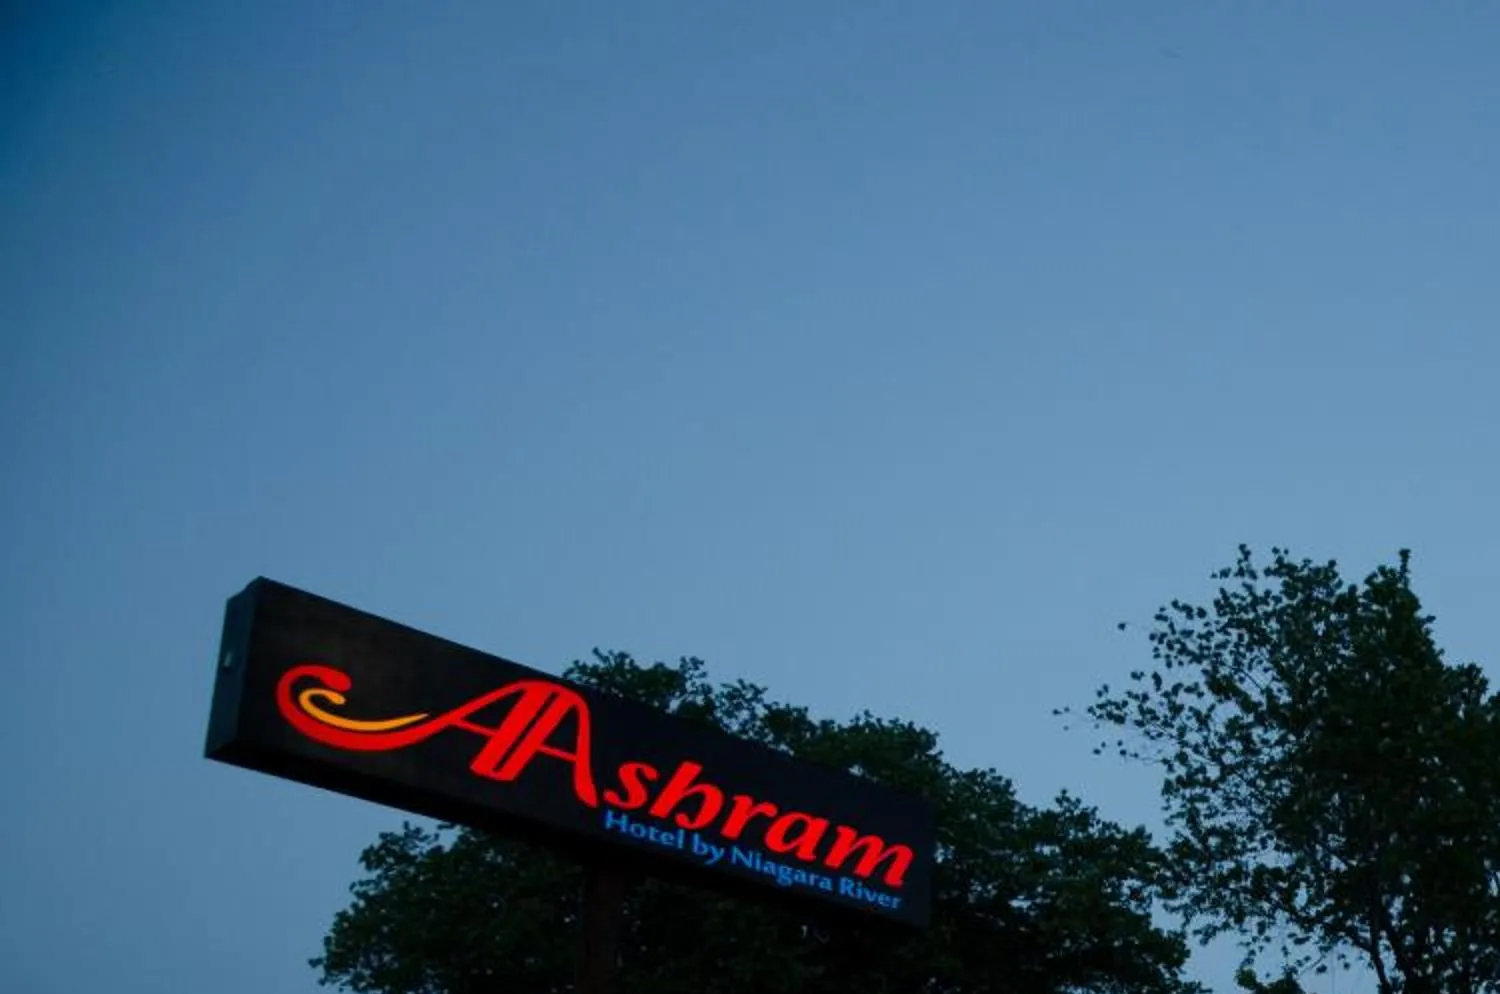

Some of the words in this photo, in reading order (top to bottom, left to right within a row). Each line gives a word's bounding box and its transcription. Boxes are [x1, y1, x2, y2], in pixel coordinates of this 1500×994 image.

[604, 809, 686, 850] Hotel
[692, 832, 726, 866] by
[730, 846, 834, 892] Niagara
[838, 876, 903, 910] River
